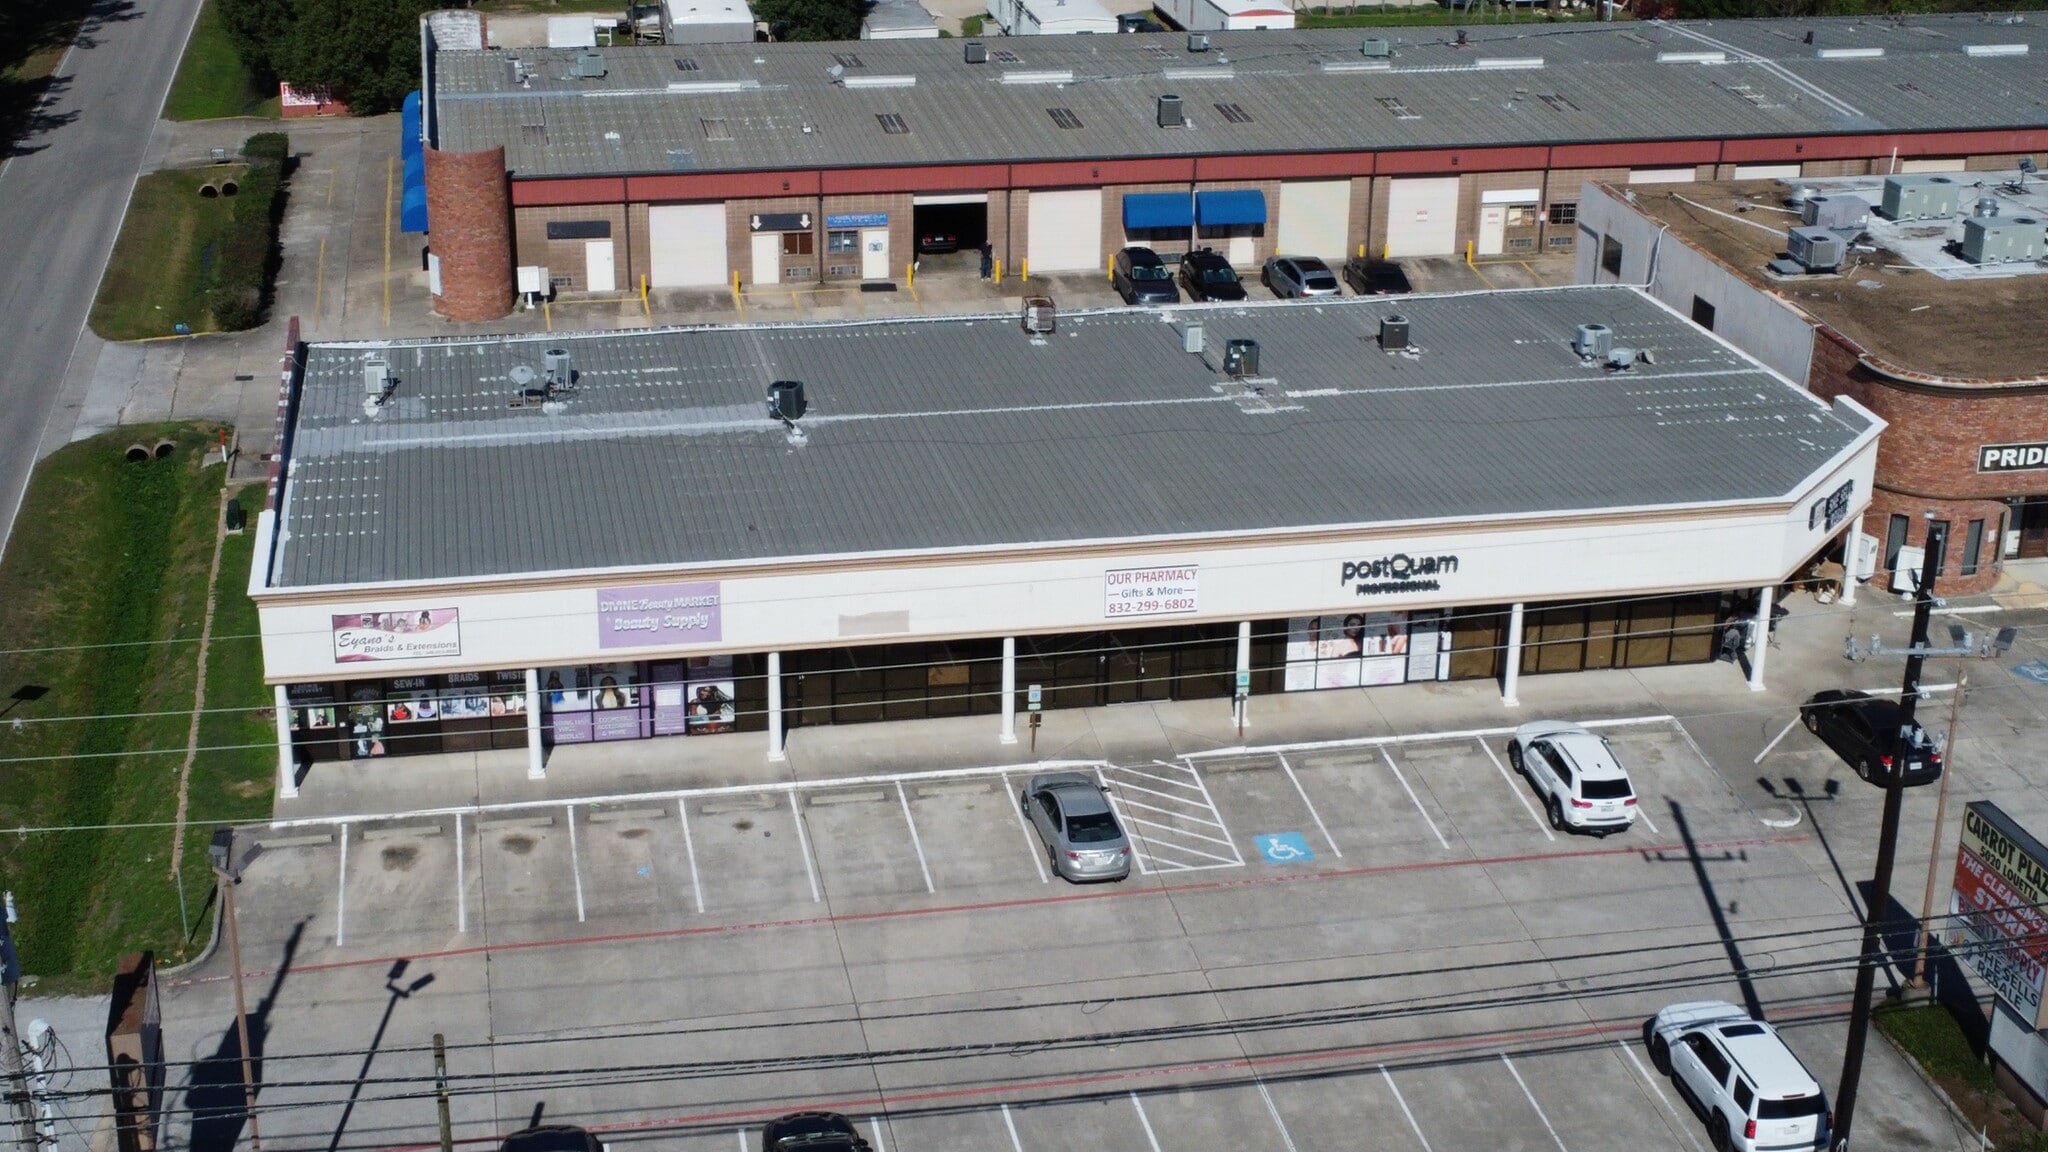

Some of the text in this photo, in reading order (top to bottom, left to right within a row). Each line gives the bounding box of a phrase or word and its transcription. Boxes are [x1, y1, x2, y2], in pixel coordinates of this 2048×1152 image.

[1107, 568, 1198, 585] OUR PHARMACY
[1341, 553, 1459, 587] postQuam
[1121, 586, 1183, 598] Gifts & More
[1356, 579, 1441, 596] PROFESSIONAL
[600, 599, 639, 613] DIVINE
[673, 594, 719, 608] MARKET
[1108, 598, 1195, 613] 832-299-6802
[613, 612, 709, 632] Beauty Supply
[338, 632, 395, 649] Eyano's
[364, 645, 394, 653] Braids
[406, 641, 457, 651] Extensions
[393, 679, 425, 689] SEW-IN
[496, 670, 526, 680] TWISTS
[1966, 811, 2016, 865] CARROT
[1961, 851, 1984, 878] THE
[1980, 846, 2039, 902] 5020 LOUETTA
[1974, 887, 2030, 937] STORE
[1976, 959, 2022, 1011] RESALE
[2002, 967, 2038, 1008] SELLS
